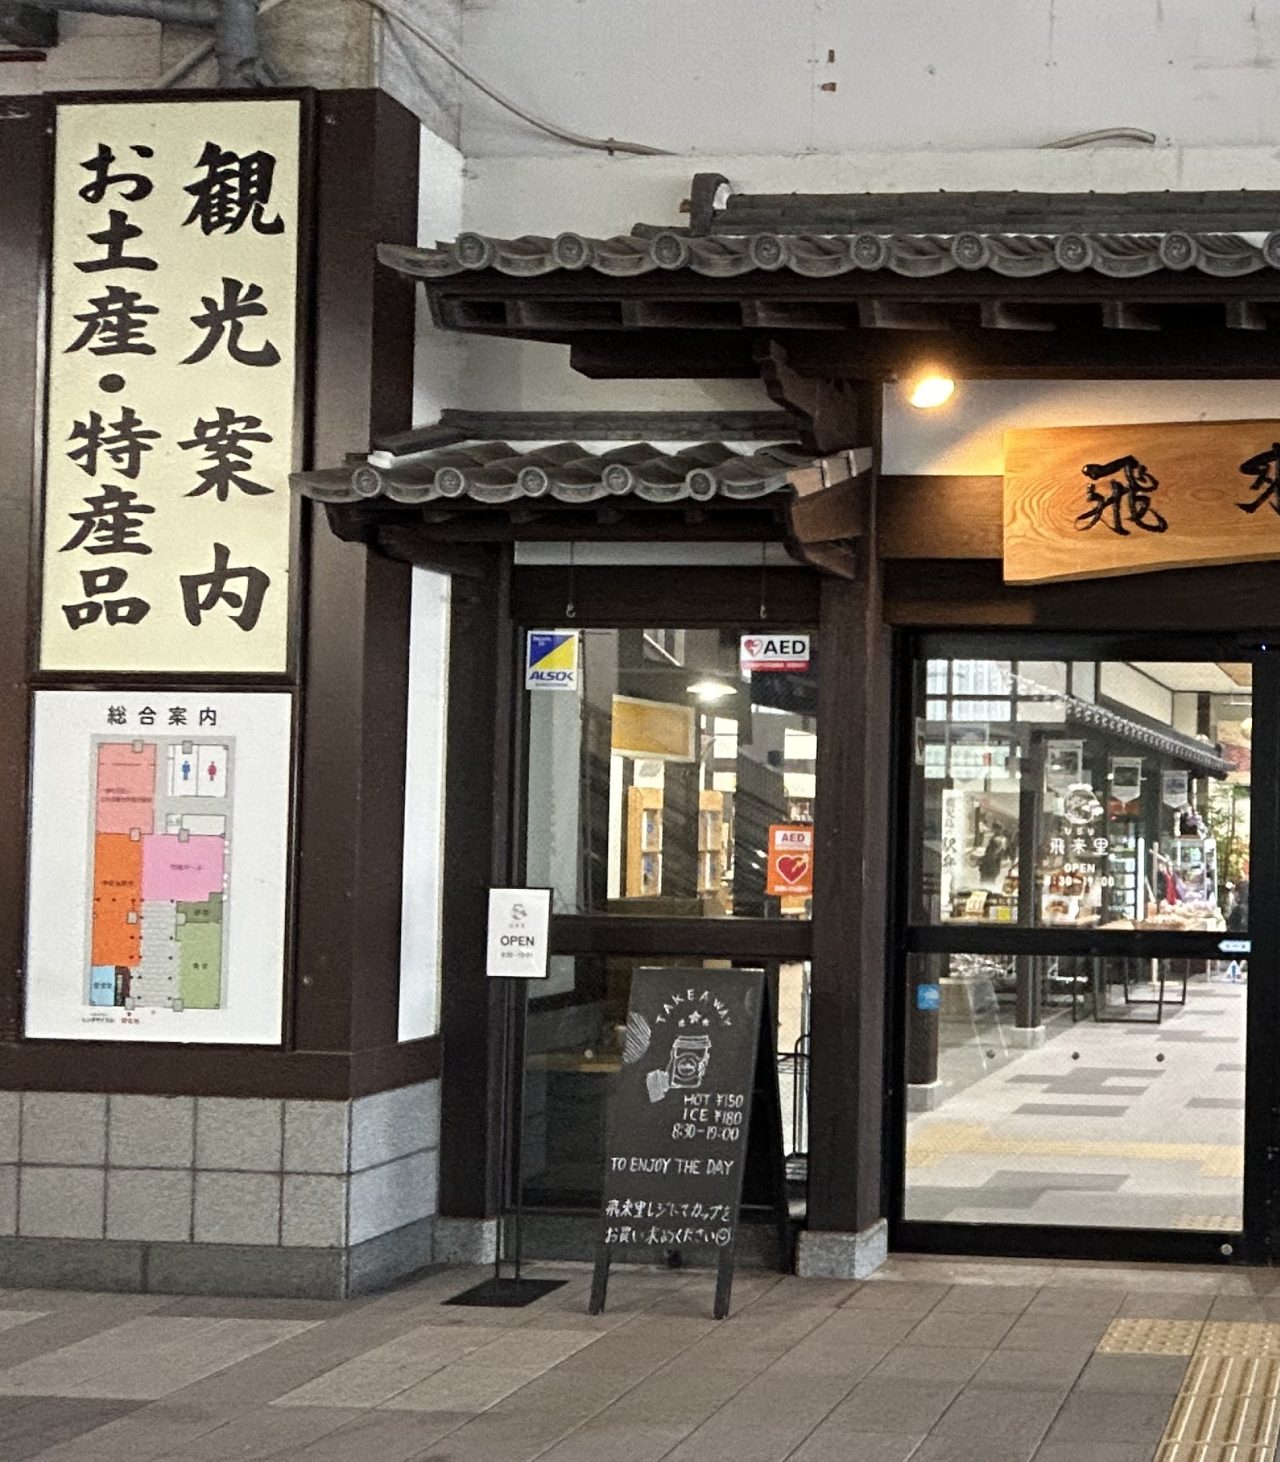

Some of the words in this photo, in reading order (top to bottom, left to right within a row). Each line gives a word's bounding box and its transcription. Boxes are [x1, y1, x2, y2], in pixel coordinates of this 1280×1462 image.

[58, 142, 162, 631] お土産・特産品
[178, 141, 285, 632] 観光案内
[763, 640, 806, 655] AED
[529, 671, 574, 681] ALSOK
[107, 705, 218, 726] 総合案内
[781, 832, 805, 843] AED
[1063, 863, 1096, 874] OPEN
[500, 935, 535, 947] OPEN
[684, 1093, 711, 1106] HOT
[683, 1108, 709, 1121] ICE
[611, 1157, 627, 1171] TO
[630, 1157, 671, 1174] ENJOY
[674, 1158, 701, 1175] THE
[706, 1159, 734, 1175] DAY
